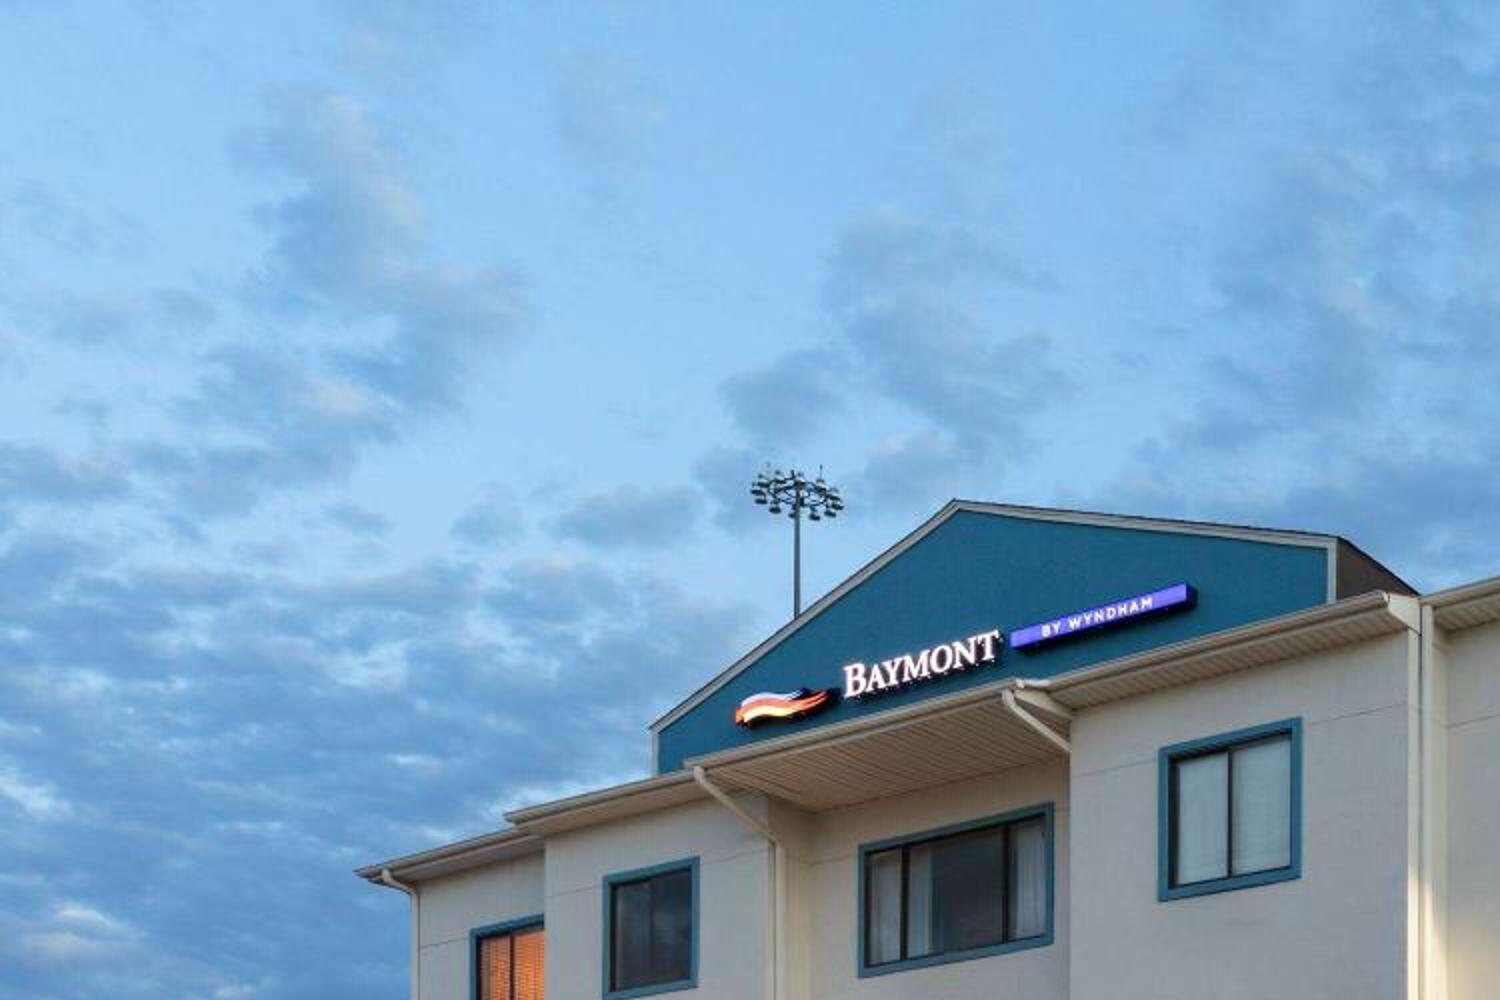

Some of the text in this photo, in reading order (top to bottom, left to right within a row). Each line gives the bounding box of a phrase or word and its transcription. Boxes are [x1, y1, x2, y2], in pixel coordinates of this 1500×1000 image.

[844, 597, 1154, 698] BAYMONT BY WYNDHAM
